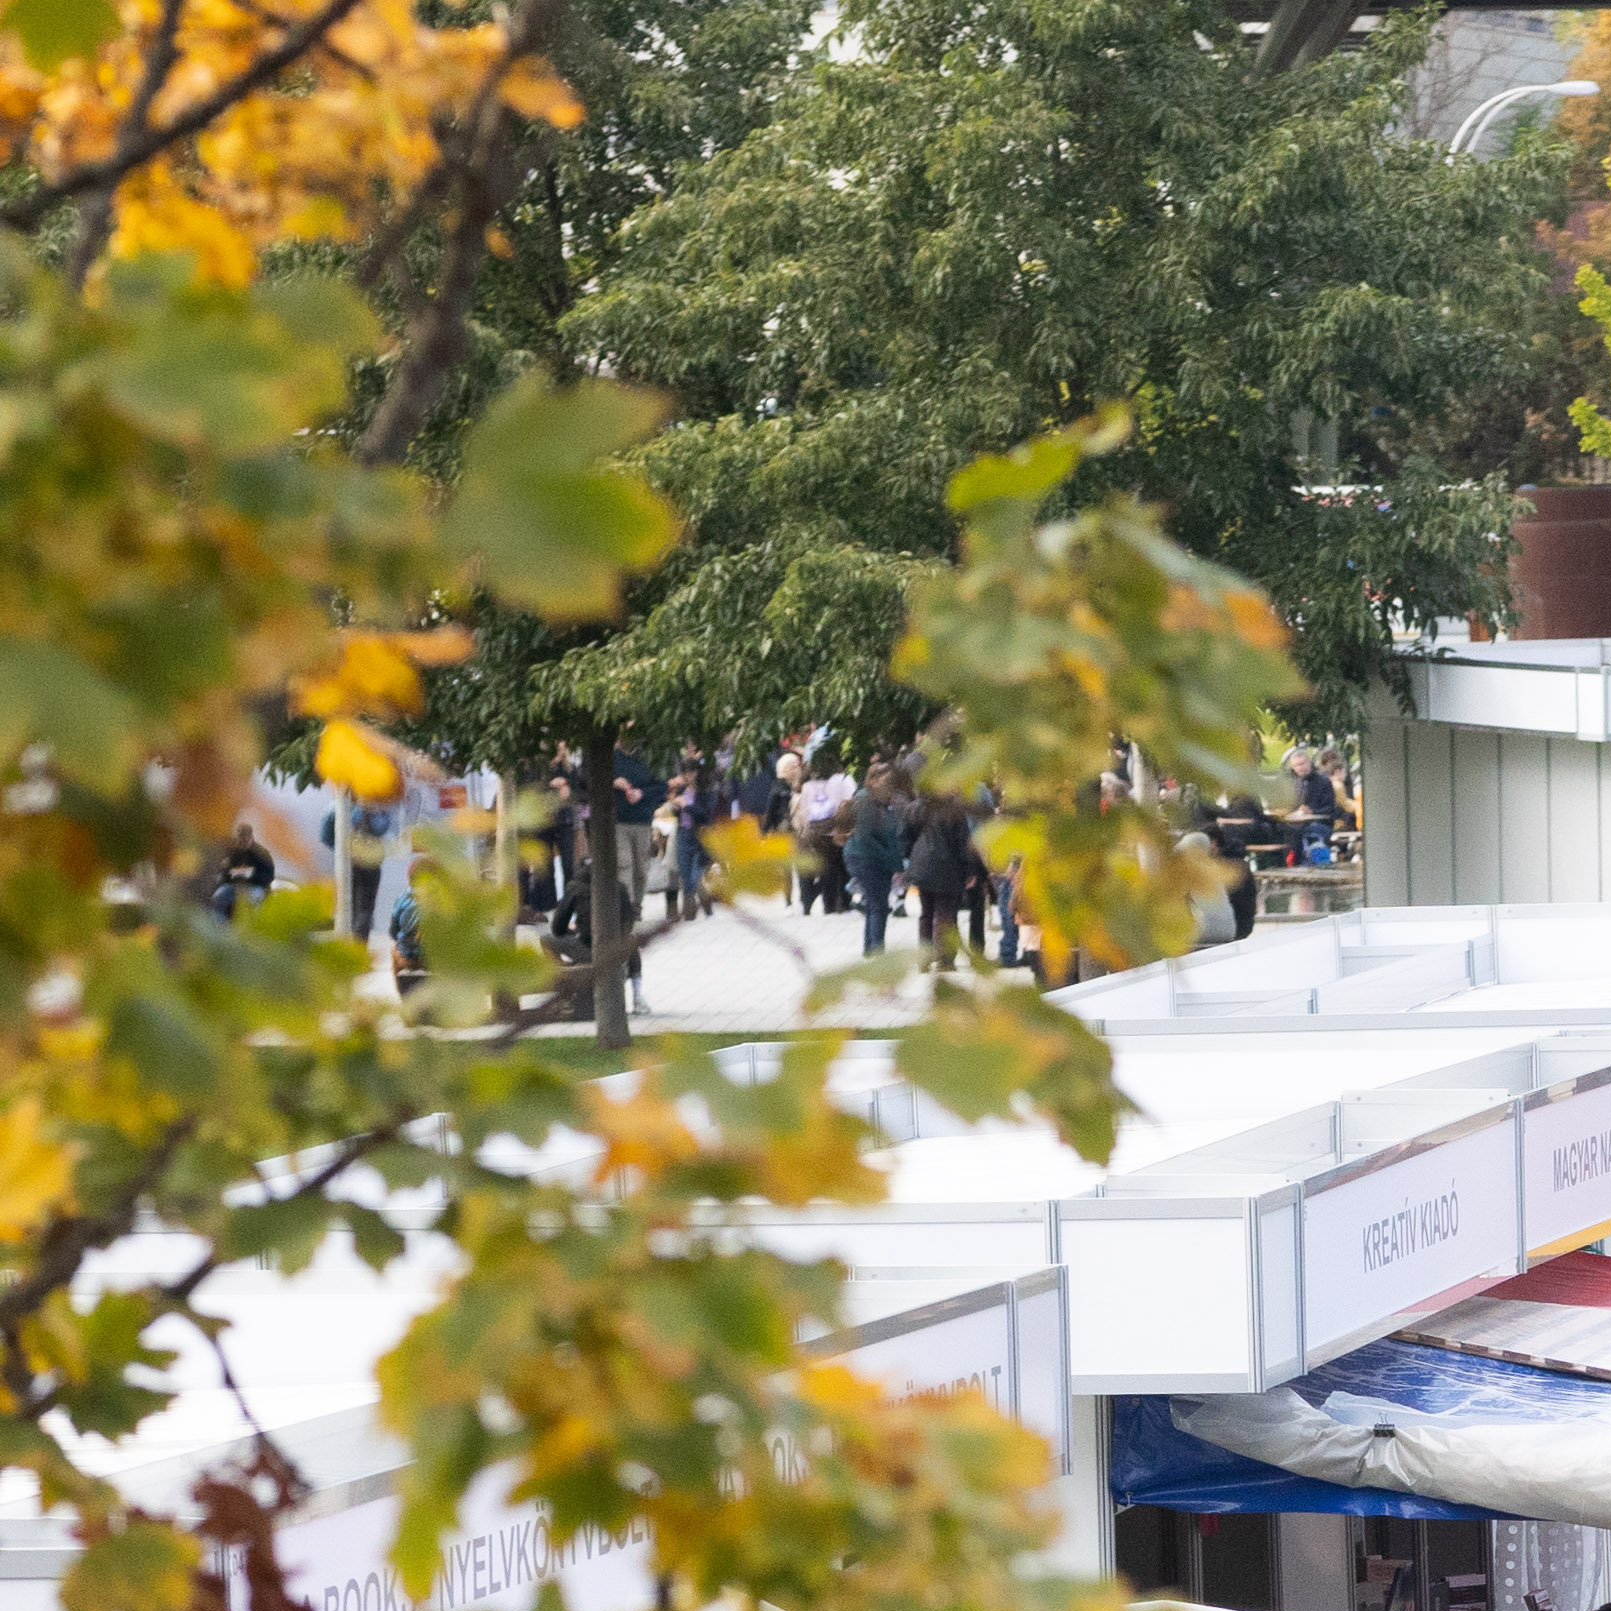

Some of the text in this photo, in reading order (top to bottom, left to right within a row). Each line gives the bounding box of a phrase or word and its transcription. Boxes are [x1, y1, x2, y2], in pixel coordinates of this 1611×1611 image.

[1553, 1135, 1598, 1192] MAGYAR
[1362, 1177, 1459, 1274] KREATÍV KIADÓ
